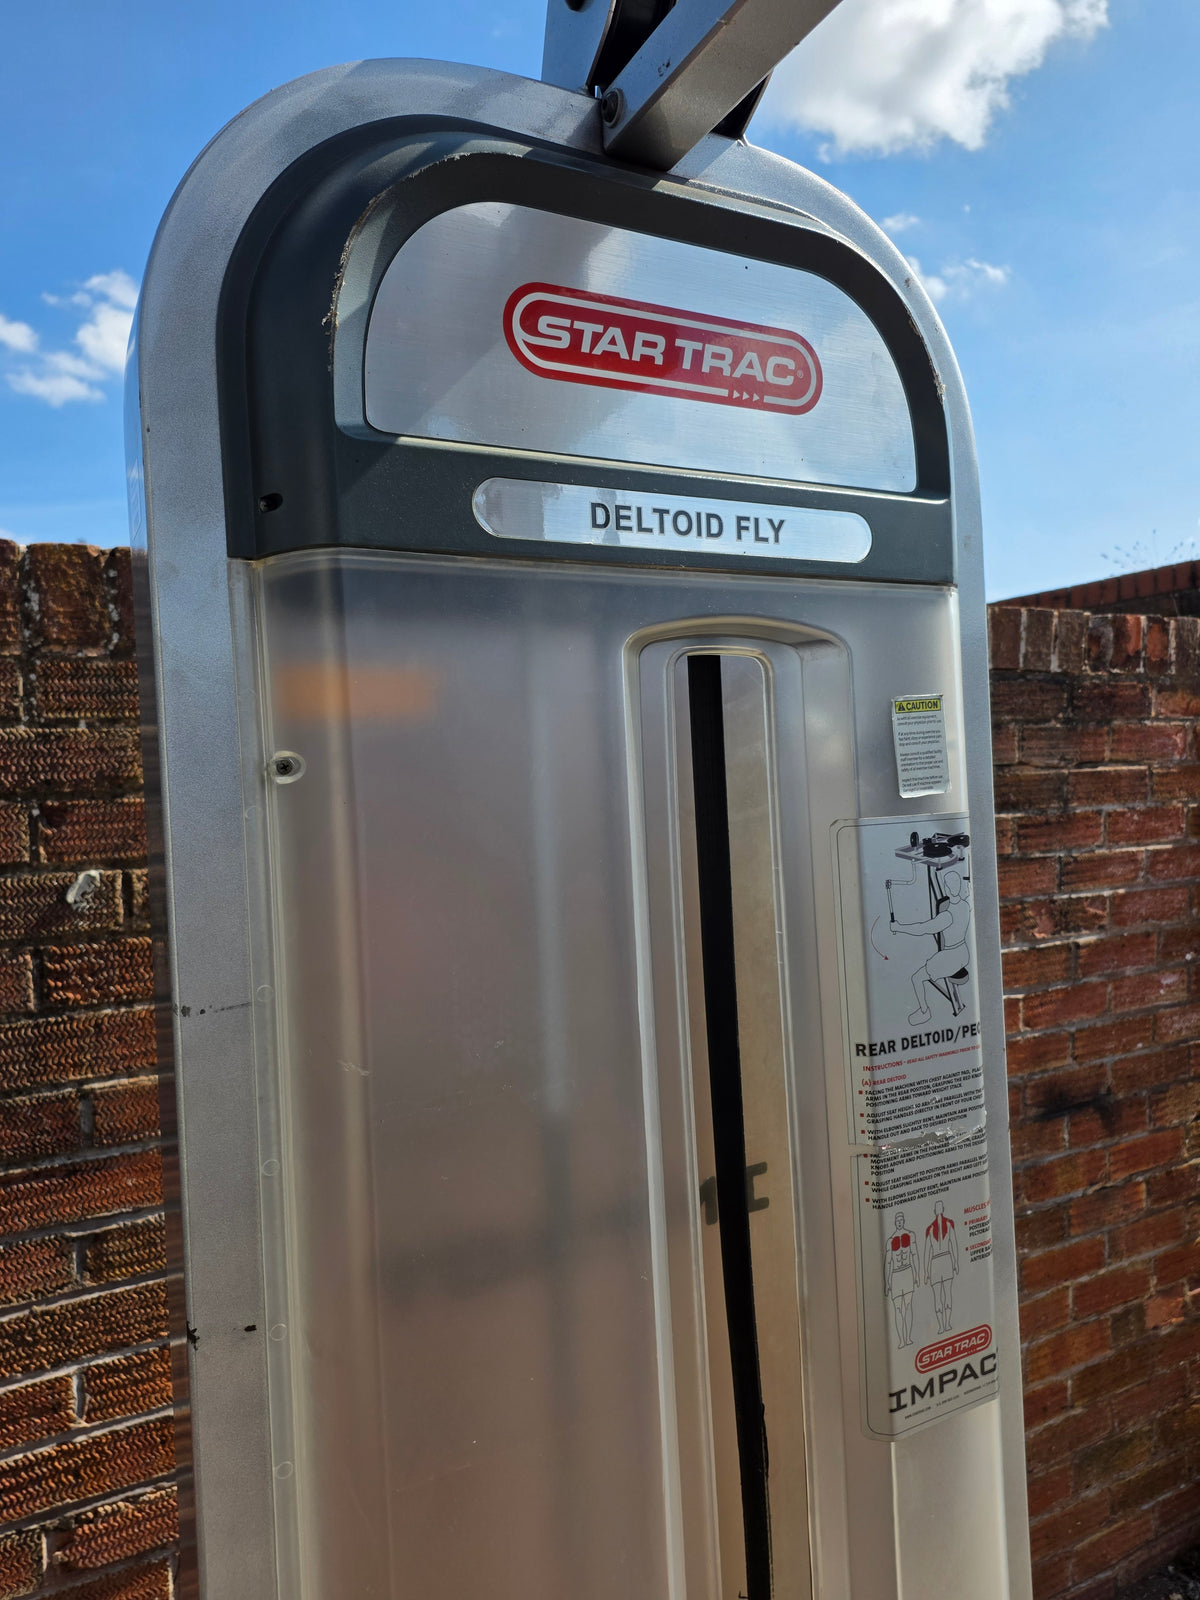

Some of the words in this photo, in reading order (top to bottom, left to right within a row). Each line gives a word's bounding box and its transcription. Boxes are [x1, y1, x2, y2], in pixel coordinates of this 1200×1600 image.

[535, 314, 666, 366] STAR
[675, 338, 797, 387] TRAC
[590, 501, 724, 539] DELTOID
[736, 515, 785, 545] FLY
[906, 700, 938, 711] CAUTION
[855, 1039, 896, 1057] REAR
[863, 1059, 902, 1072] INSTRUCTIONS
[887, 1073, 907, 1083] DELTOID
[865, 1088, 884, 1096] FACING
[895, 1082, 915, 1090] MACHINE
[866, 1110, 886, 1118] ADJUST
[884, 1124, 902, 1132] ELBOWS
[872, 1202, 893, 1210] HANDLE
[894, 1195, 916, 1205] FORWARD
[888, 1192, 906, 1201] ELBOWS
[964, 1202, 986, 1214] MUSCLES
[922, 1345, 952, 1365] STAR
[955, 1332, 986, 1352] TRAC
[888, 1347, 998, 1414] IMPAC
